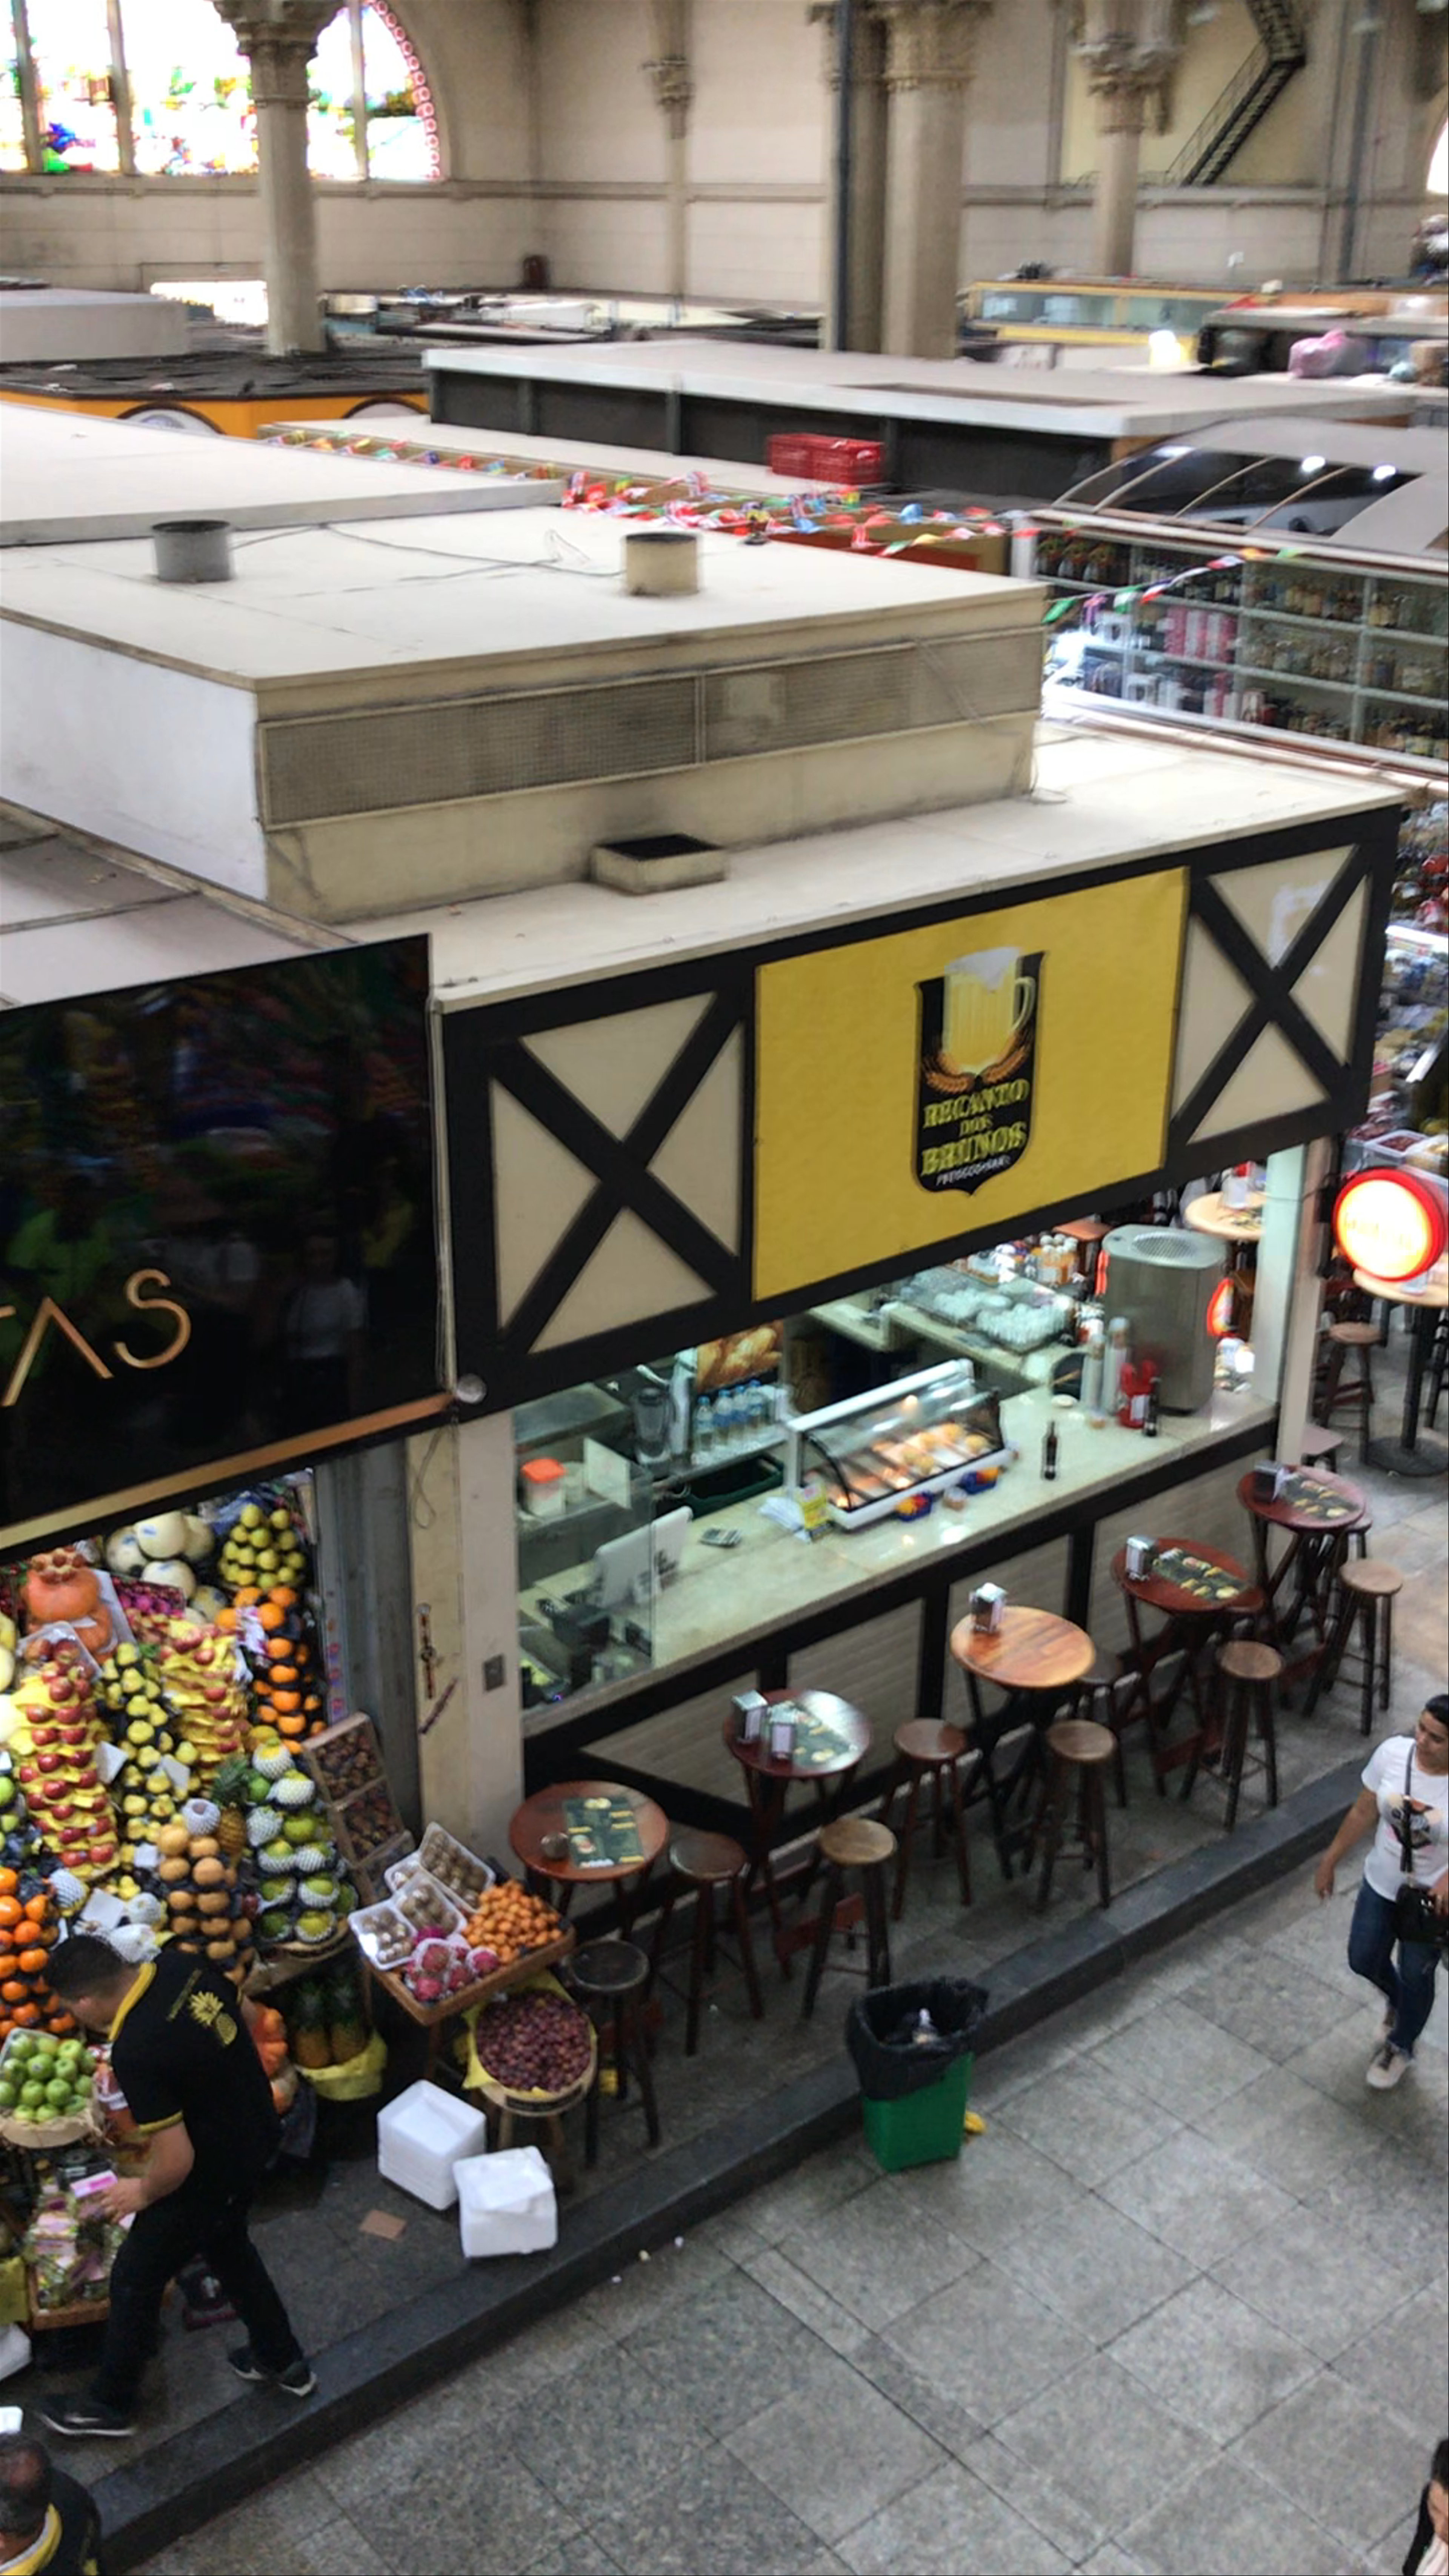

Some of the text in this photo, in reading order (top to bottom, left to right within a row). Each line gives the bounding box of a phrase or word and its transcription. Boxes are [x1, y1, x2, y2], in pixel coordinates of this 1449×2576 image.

[923, 1078, 1030, 1128] RECANTO
[960, 1114, 993, 1137] DOS
[921, 1121, 1027, 1177] BRUNOS
[0, 1268, 191, 1407] AS
